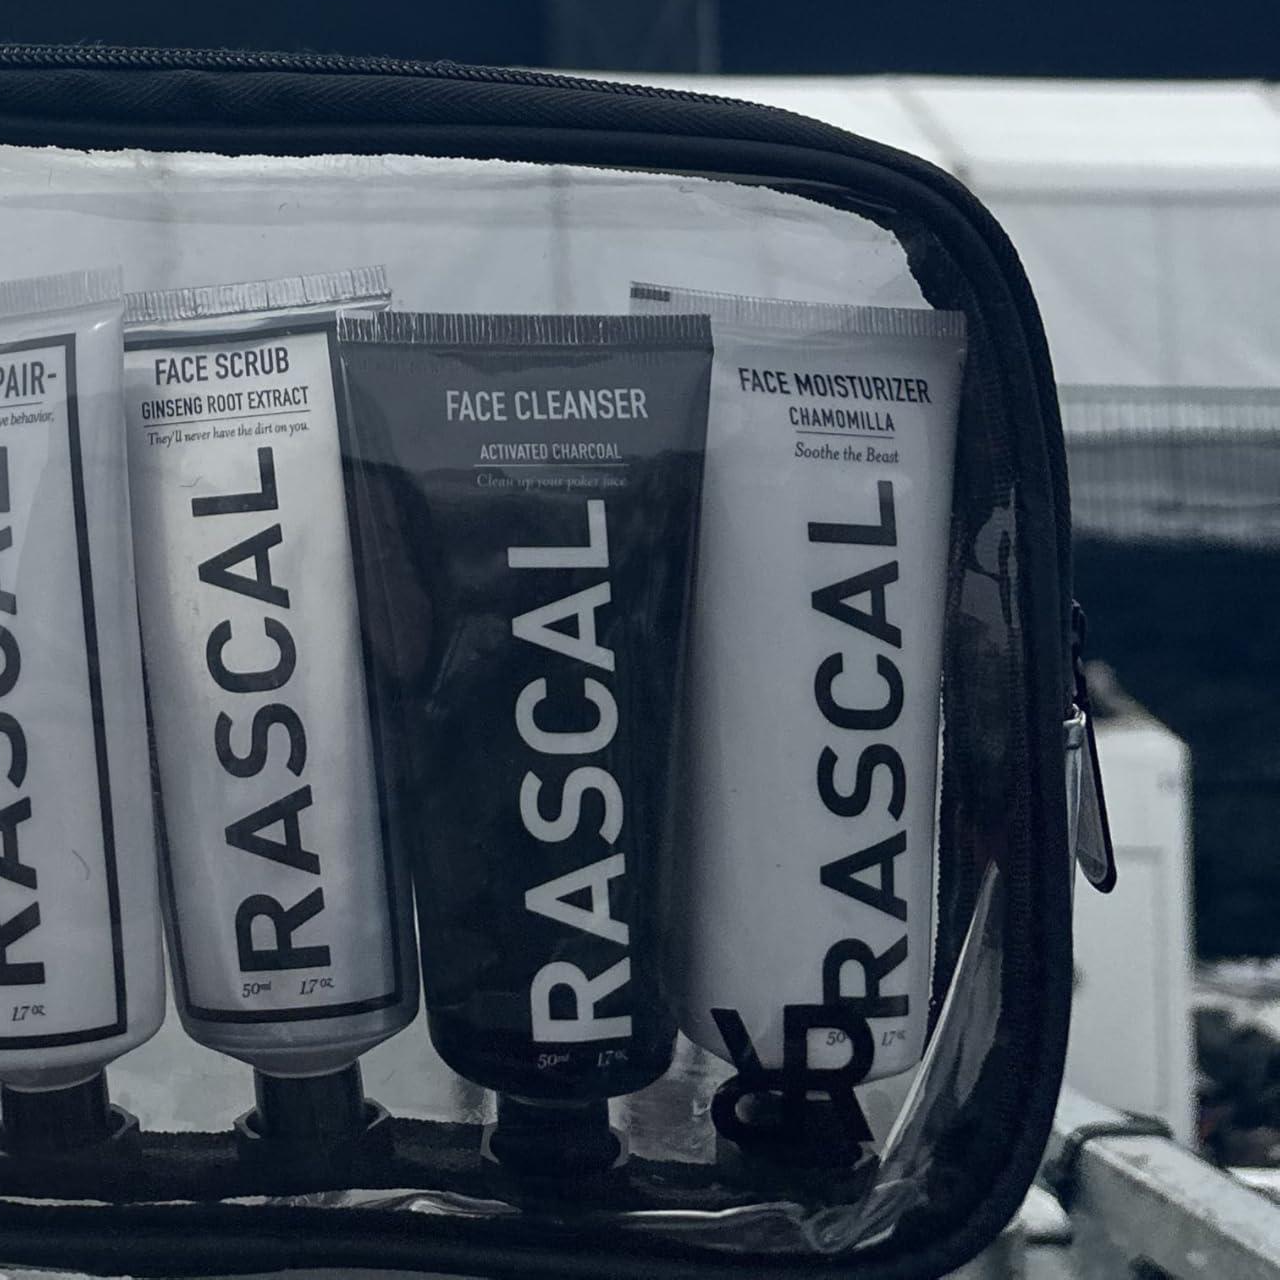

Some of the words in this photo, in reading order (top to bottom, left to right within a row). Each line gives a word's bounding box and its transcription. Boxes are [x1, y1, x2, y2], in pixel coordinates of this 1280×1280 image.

[155, 355, 208, 385] FACE
[215, 347, 289, 379] SCRUB
[738, 367, 791, 394] FACE
[793, 372, 932, 404] MOISTURIZER
[141, 397, 203, 420] GINSENG
[207, 392, 243, 413] ROOT
[248, 386, 310, 409] EXTRACT
[446, 390, 507, 421] FACE
[515, 388, 648, 420] CLEANSER
[789, 406, 895, 432] CHAMOMILLA
[148, 430, 182, 447] They'll
[184, 431, 211, 442] never
[213, 426, 235, 439] have
[237, 424, 252, 437] the
[254, 422, 273, 435] dirt
[275, 423, 287, 433] on
[480, 443, 548, 460] ACTIVATED
[552, 442, 623, 460] CHARCOAL
[794, 441, 840, 461] Soothe
[843, 445, 862, 462] the
[866, 446, 899, 464] Beast
[191, 446, 332, 972] RASCAL
[808, 480, 909, 1019] RASCAL
[507, 499, 632, 1043] RASCAL
